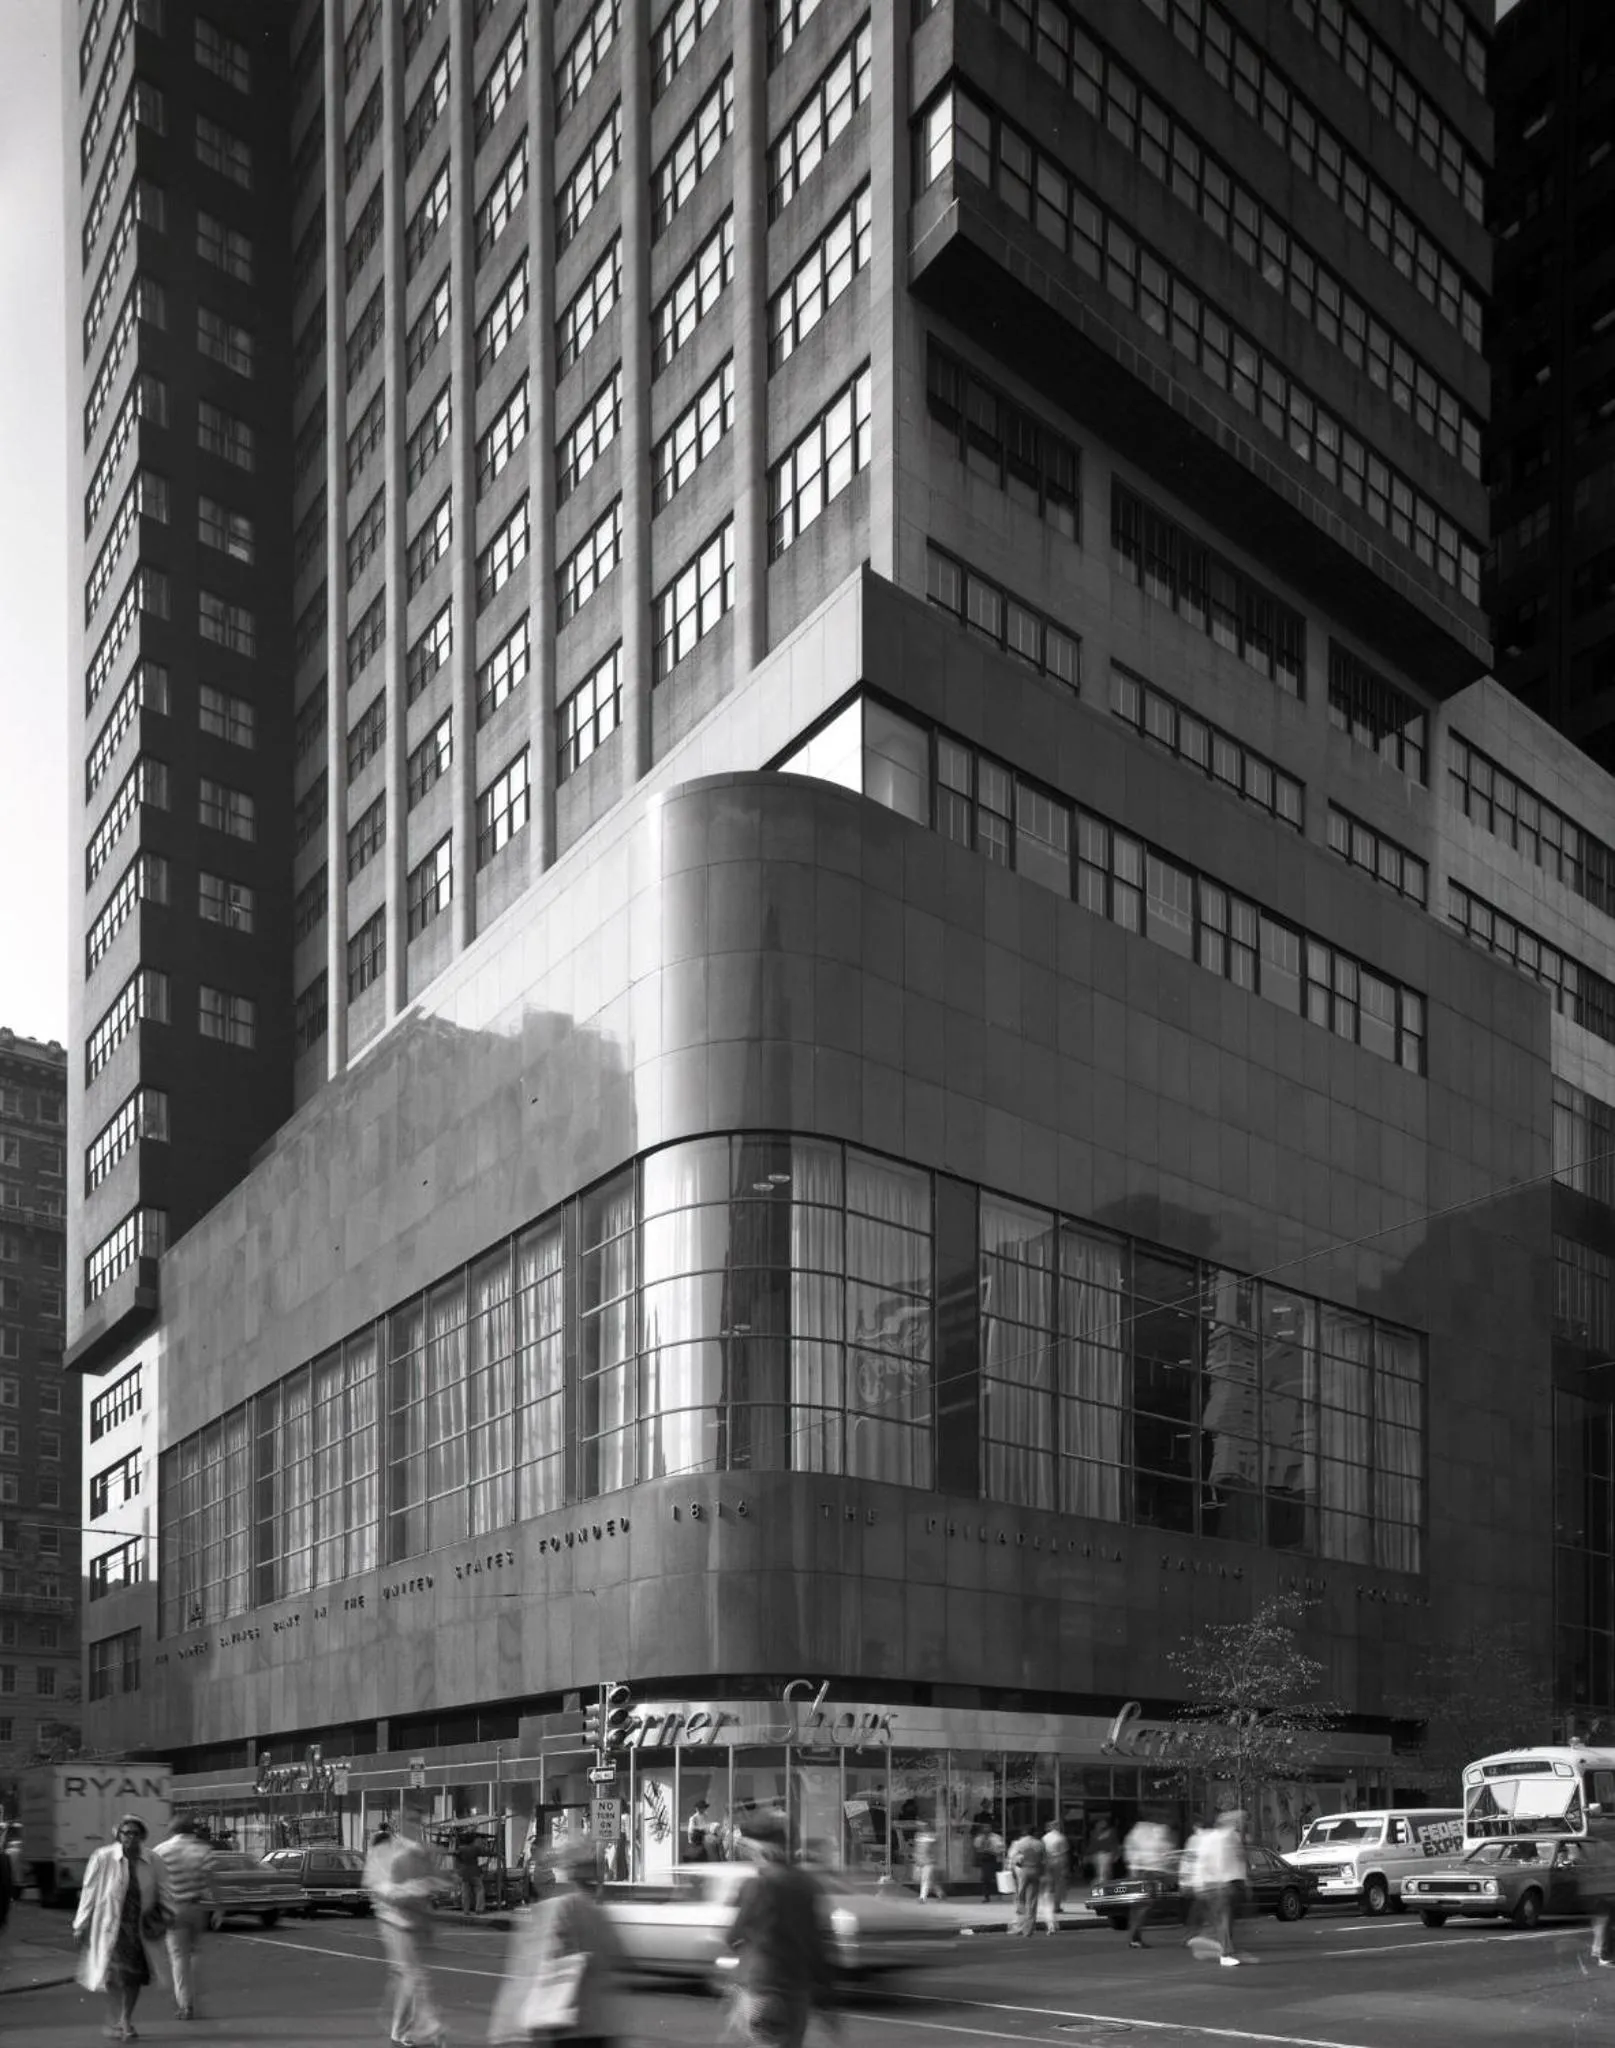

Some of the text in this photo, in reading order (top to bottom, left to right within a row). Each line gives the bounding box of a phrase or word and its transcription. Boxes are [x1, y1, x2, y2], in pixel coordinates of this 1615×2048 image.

[820, 1503, 880, 1526] THE
[344, 1595, 365, 1611] THE
[382, 1575, 434, 1601] UNITED
[454, 1550, 515, 1580] STATES
[538, 1515, 631, 1555] FOUNDED
[671, 1500, 749, 1523] 1816
[622, 1679, 898, 1755] orner Shops
[64, 1776, 162, 1799] RYAN
[599, 1801, 614, 1811] NO
